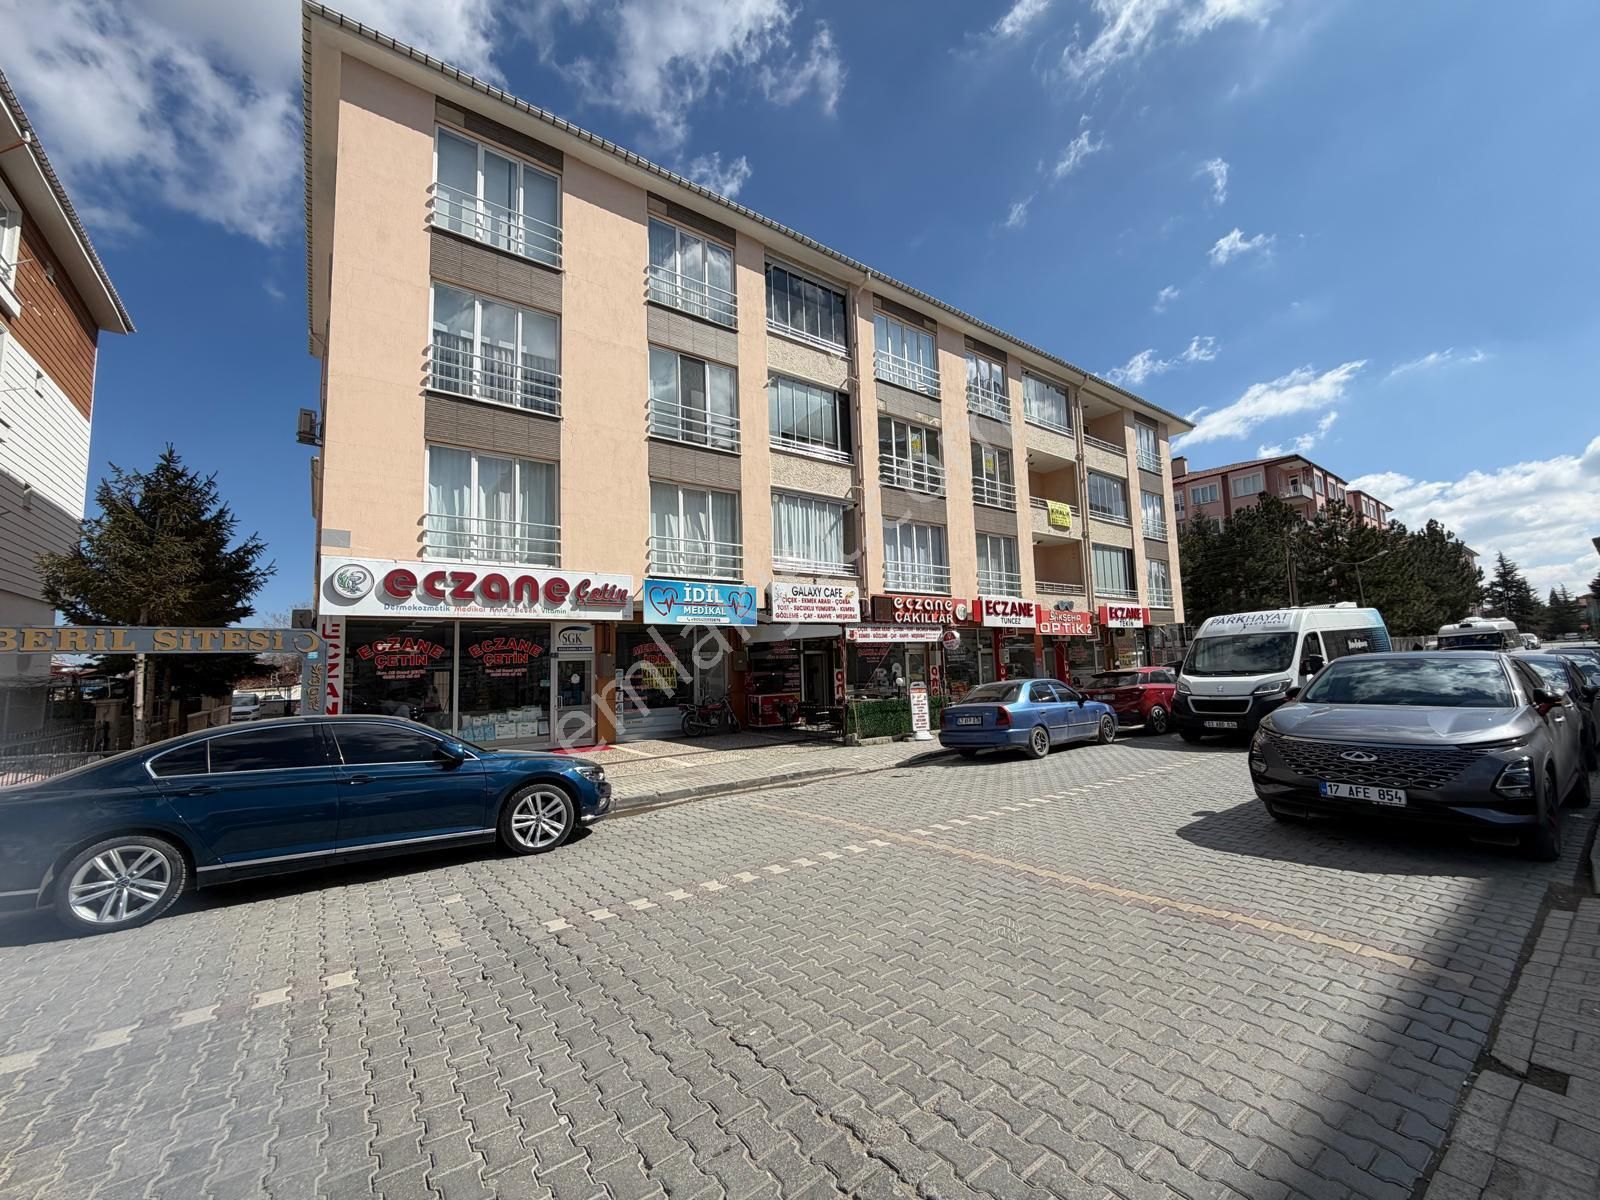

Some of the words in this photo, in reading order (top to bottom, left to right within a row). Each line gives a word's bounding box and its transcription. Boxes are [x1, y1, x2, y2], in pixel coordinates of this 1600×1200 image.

[383, 568, 570, 604] eczane
[575, 579, 628, 606] Çetin
[683, 584, 724, 603] İDİL
[792, 586, 821, 597] GALAXY
[824, 587, 842, 598] CAFE
[384, 603, 450, 612] Dermokozmetik
[894, 597, 952, 611] eczane
[985, 600, 1034, 617] ECZANE
[894, 611, 953, 623] ÇAKILLAR
[1109, 607, 1142, 620] ECZANE
[1086, 623, 1093, 634] 2
[562, 633, 583, 644] SGK
[356, 637, 446, 660] ECZANE
[468, 637, 545, 658] ECZANE
[375, 652, 428, 669] ÇETİN
[483, 651, 529, 667] ÇETİN
[1328, 784, 1339, 795] 17
[1348, 786, 1370, 798] AFE
[1378, 789, 1402, 802] 854
